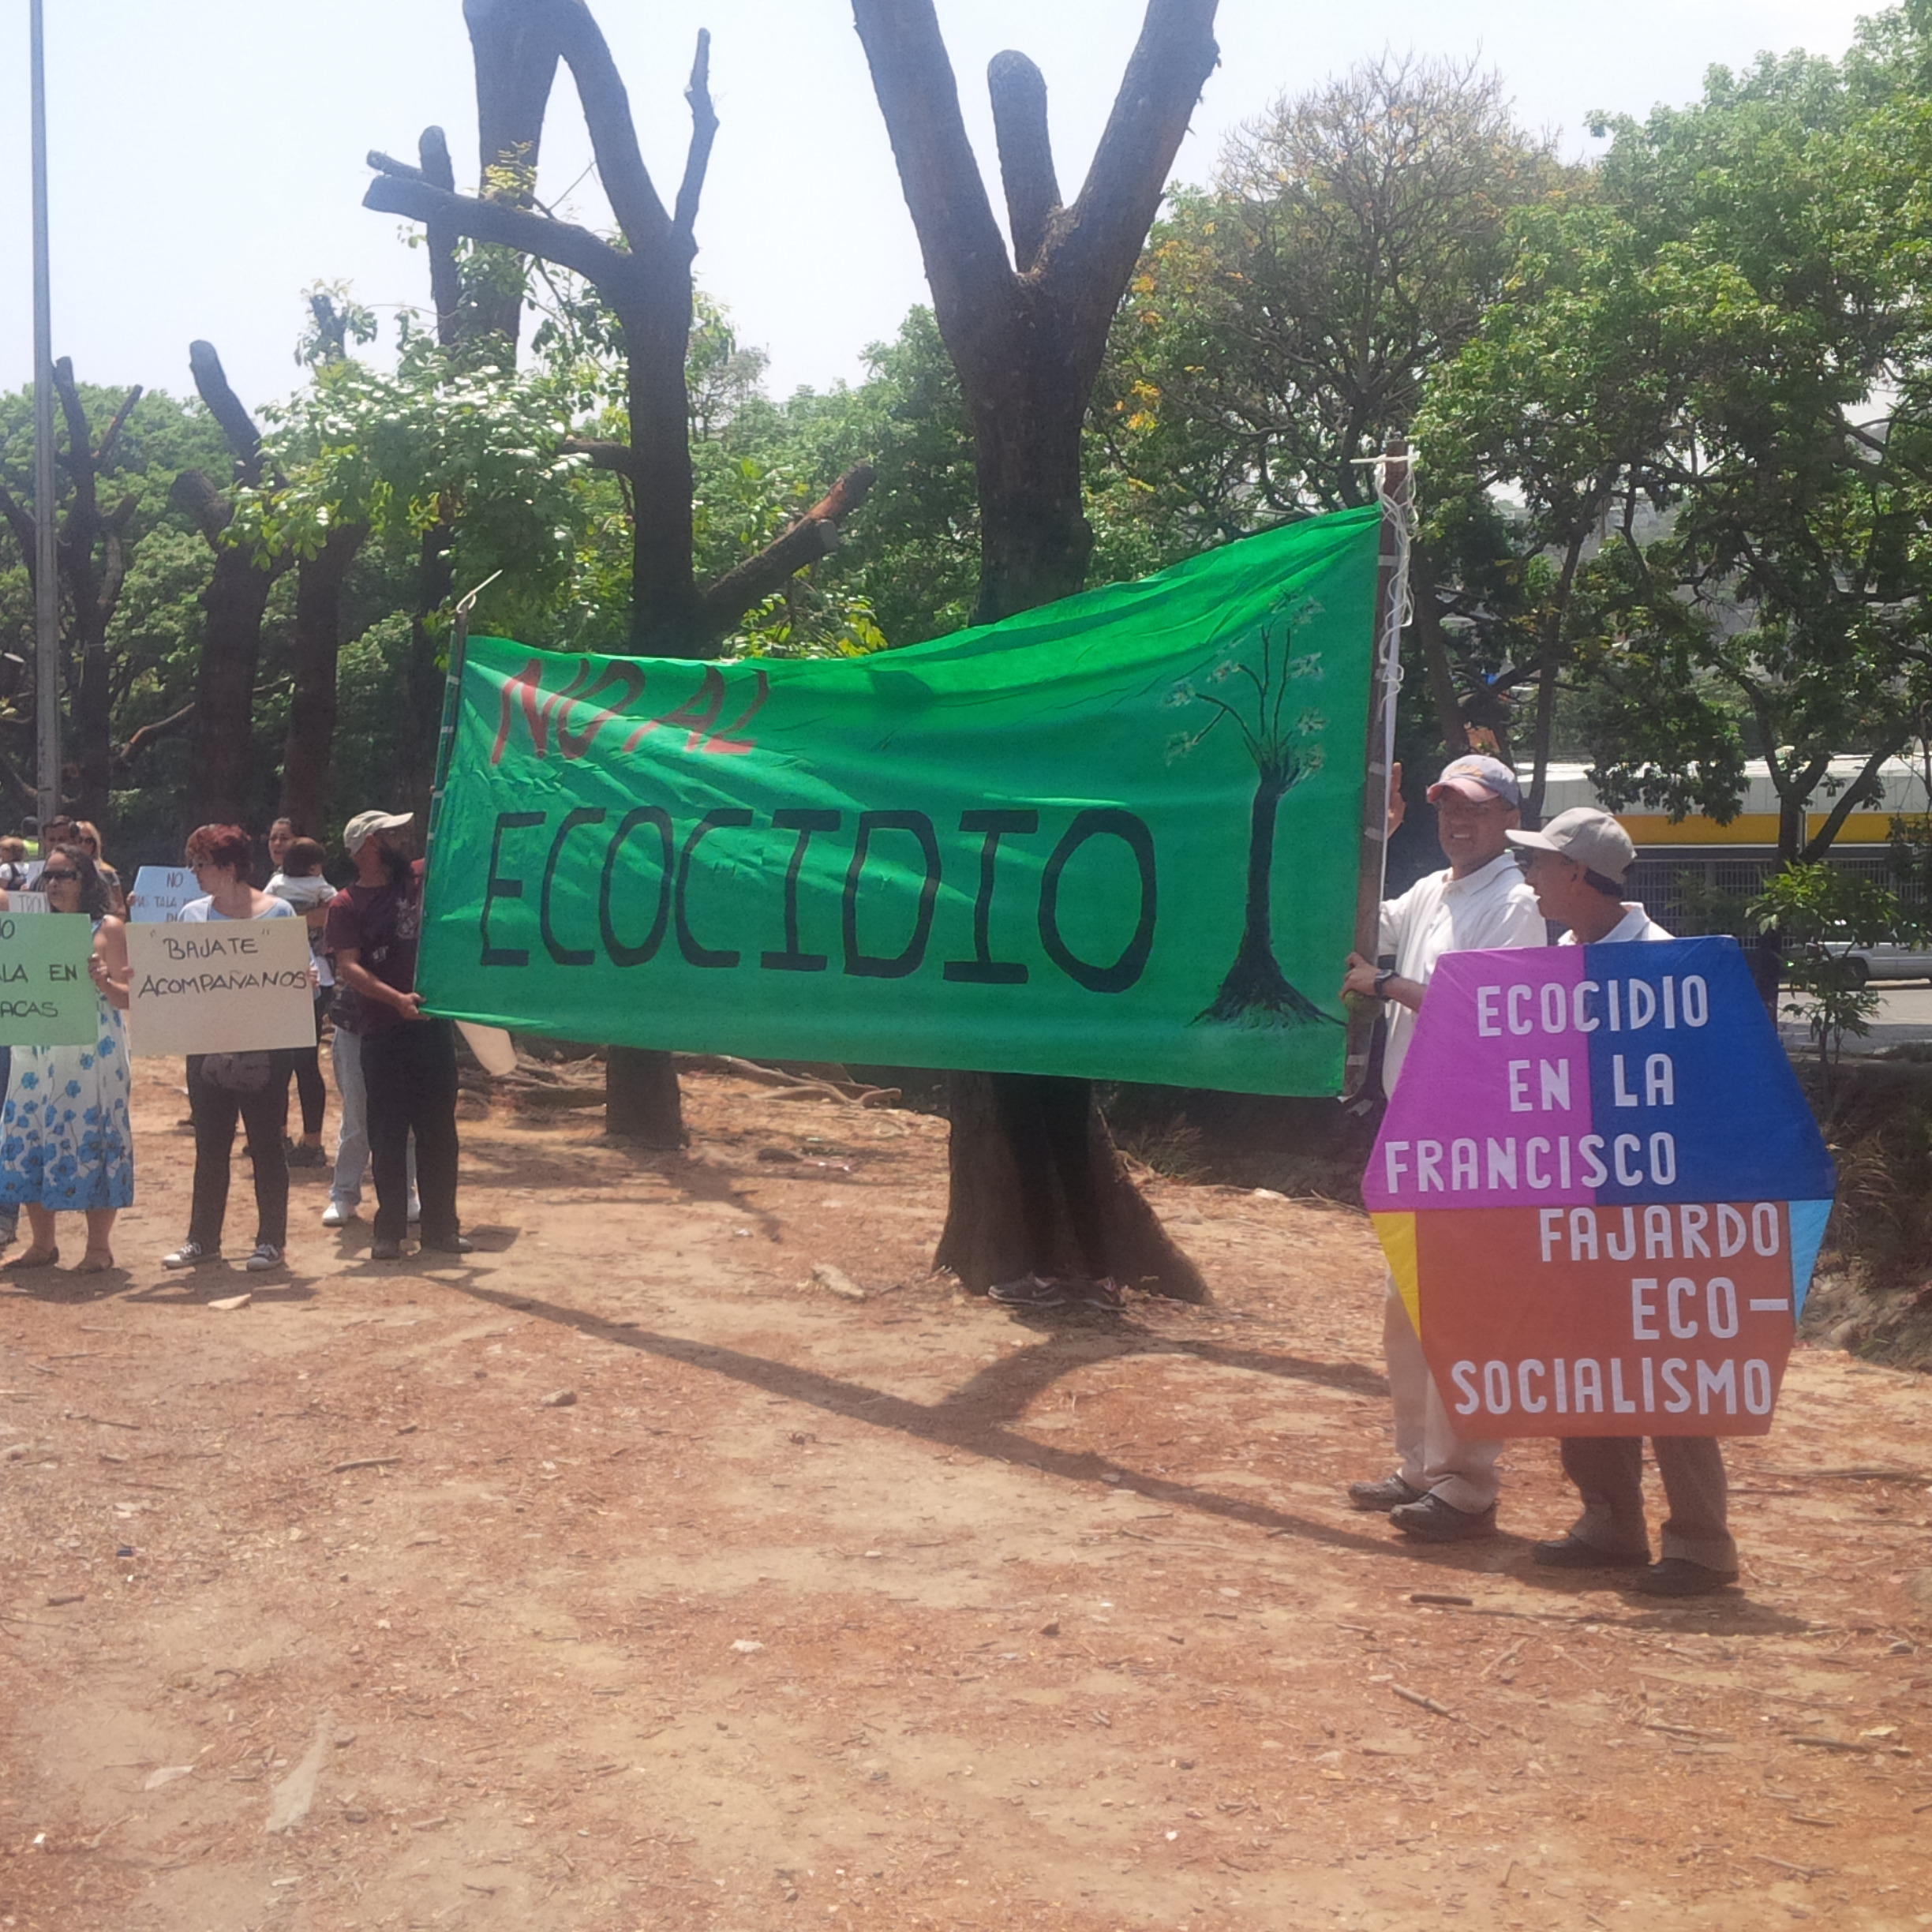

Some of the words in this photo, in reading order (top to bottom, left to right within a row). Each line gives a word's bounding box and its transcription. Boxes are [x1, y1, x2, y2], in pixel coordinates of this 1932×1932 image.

[491, 658, 646, 766] NO
[622, 665, 769, 754] AL
[154, 896, 177, 908] TALA
[167, 872, 183, 888] NO
[480, 806, 1157, 994] ECOCIDIO
[0, 918, 15, 939] O
[49, 964, 77, 982] EN
[1476, 975, 1709, 1037] ECOCIDIO
[1508, 1058, 1571, 1113] EN
[1613, 1054, 1675, 1108] LA
[1384, 1132, 1676, 1194] FRANCISCO
[1539, 1203, 1781, 1262] FAJARDO
[1451, 1357, 1773, 1415] SOCIALISMO
